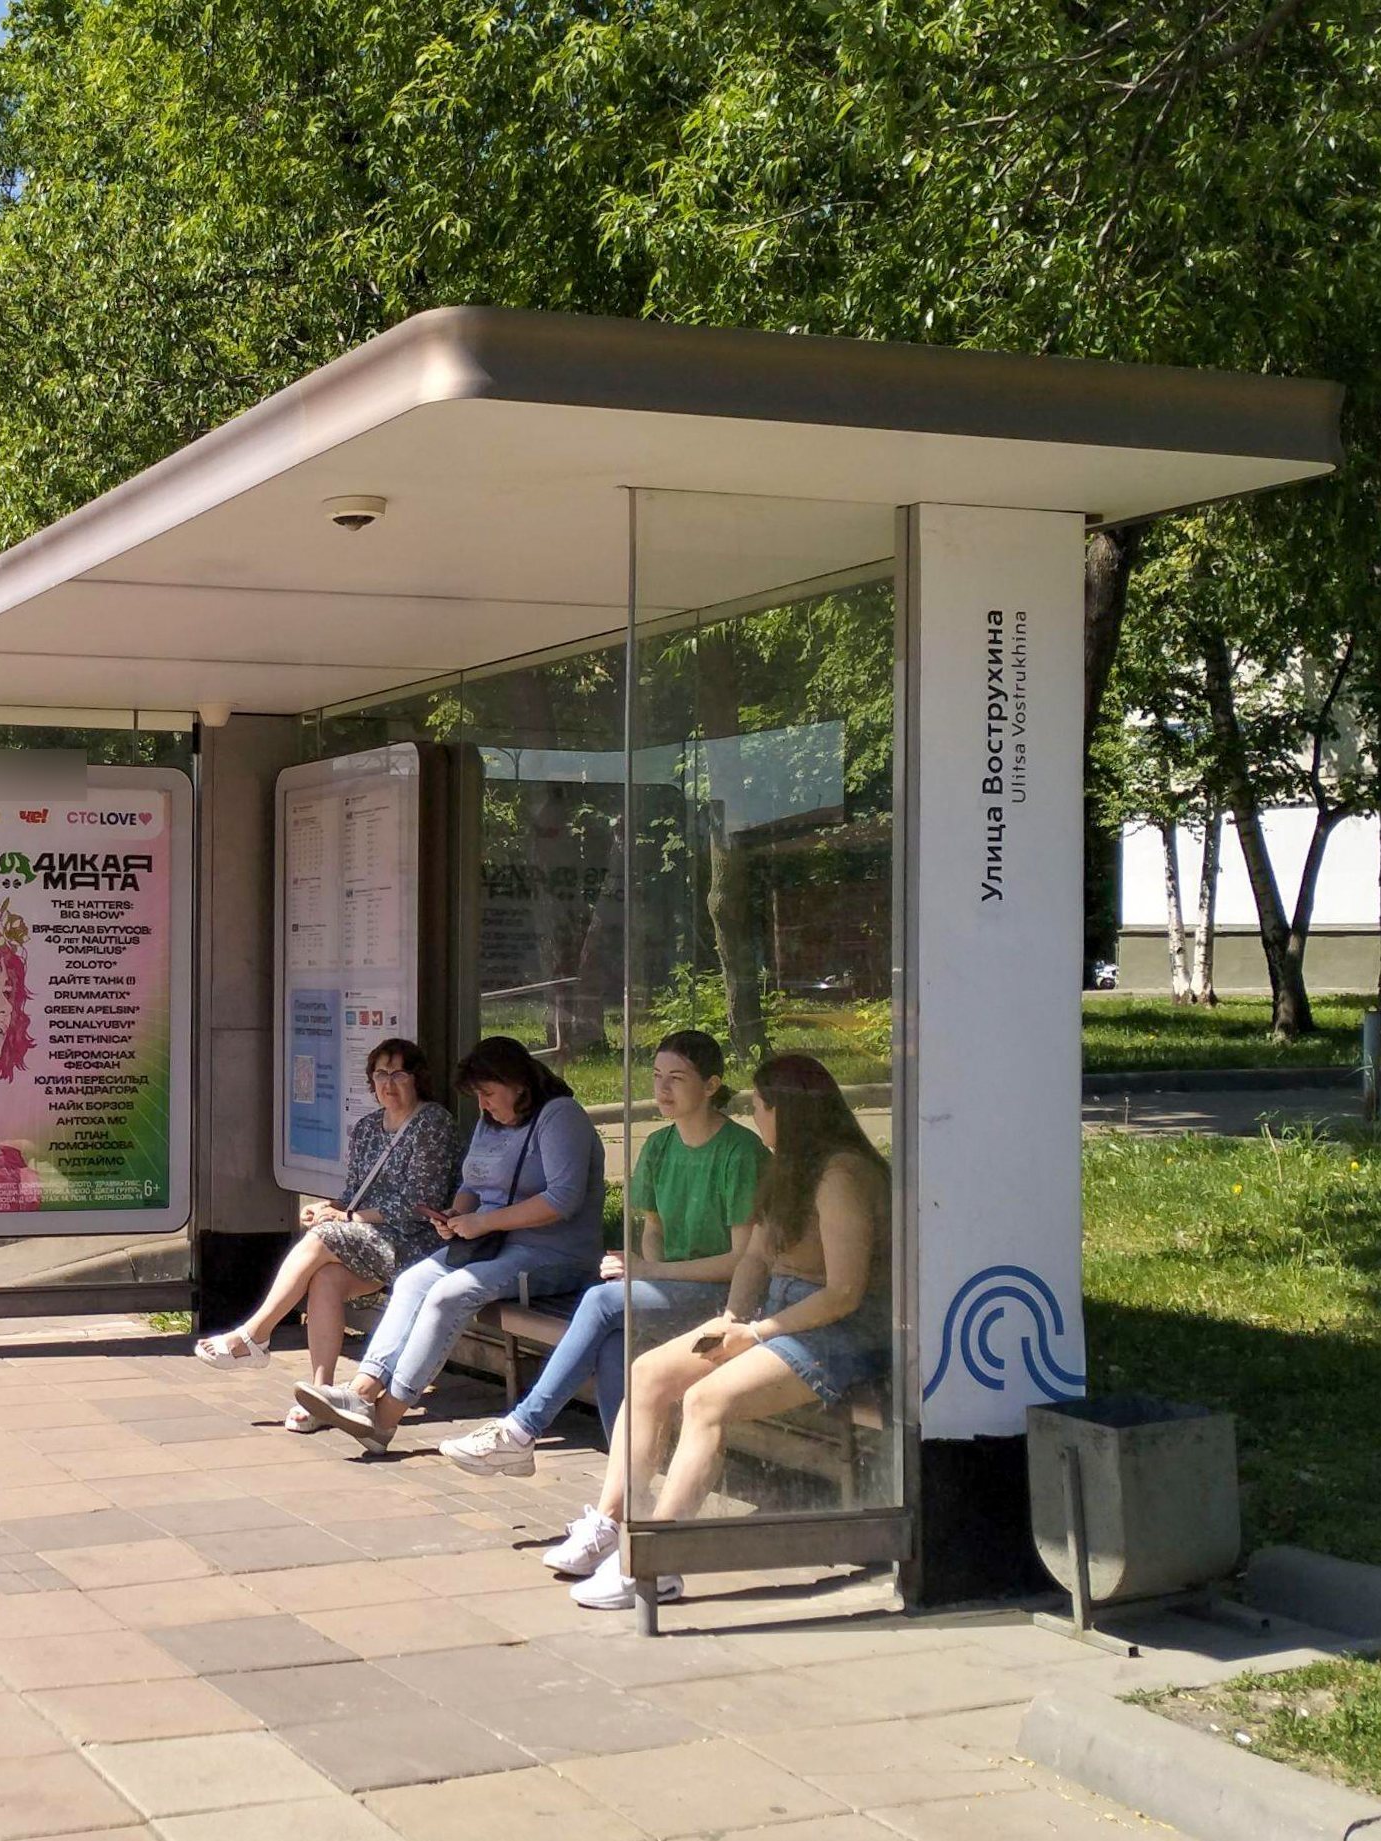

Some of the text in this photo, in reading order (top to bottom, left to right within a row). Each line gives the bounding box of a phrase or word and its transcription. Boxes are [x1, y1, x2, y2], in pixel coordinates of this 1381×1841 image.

[1011, 610, 1027, 803] Ulitsa Vostrukhina
[981, 609, 1008, 902] Улица Вострухина
[32, 853, 153, 873] ДИКАЯ
[43, 872, 140, 892] МЯТА
[51, 899, 134, 910] THE HATTERS:
[60, 910, 80, 919] BIG
[32, 924, 95, 934] ВЯЧЕСЛАВ
[45, 935, 61, 944] 40
[82, 935, 140, 945] NAUTILUS
[48, 974, 91, 986] ДАЙТЕ
[93, 976, 124, 985] ТАНК
[44, 1005, 84, 1015] GREEN
[49, 1035, 74, 1044] SATI
[49, 1049, 135, 1060] НЕЙРОМОНАХ
[64, 1061, 120, 1070] ФЕОФАН
[34, 1075, 150, 1086] ЮЛИЯ ПЕРЕСИЛЬД
[44, 1085, 139, 1096] & МАНДРАГОРА
[48, 1100, 135, 1111] НАЙК БОРЗОВ
[56, 1116, 106, 1126] АНТОХА
[74, 1131, 109, 1140] ПЛАН
[48, 1141, 134, 1151] ЛОМОНОСОВА
[58, 1156, 125, 1167] ГУДТАЙМС
[144, 1180, 161, 1196] 6+
